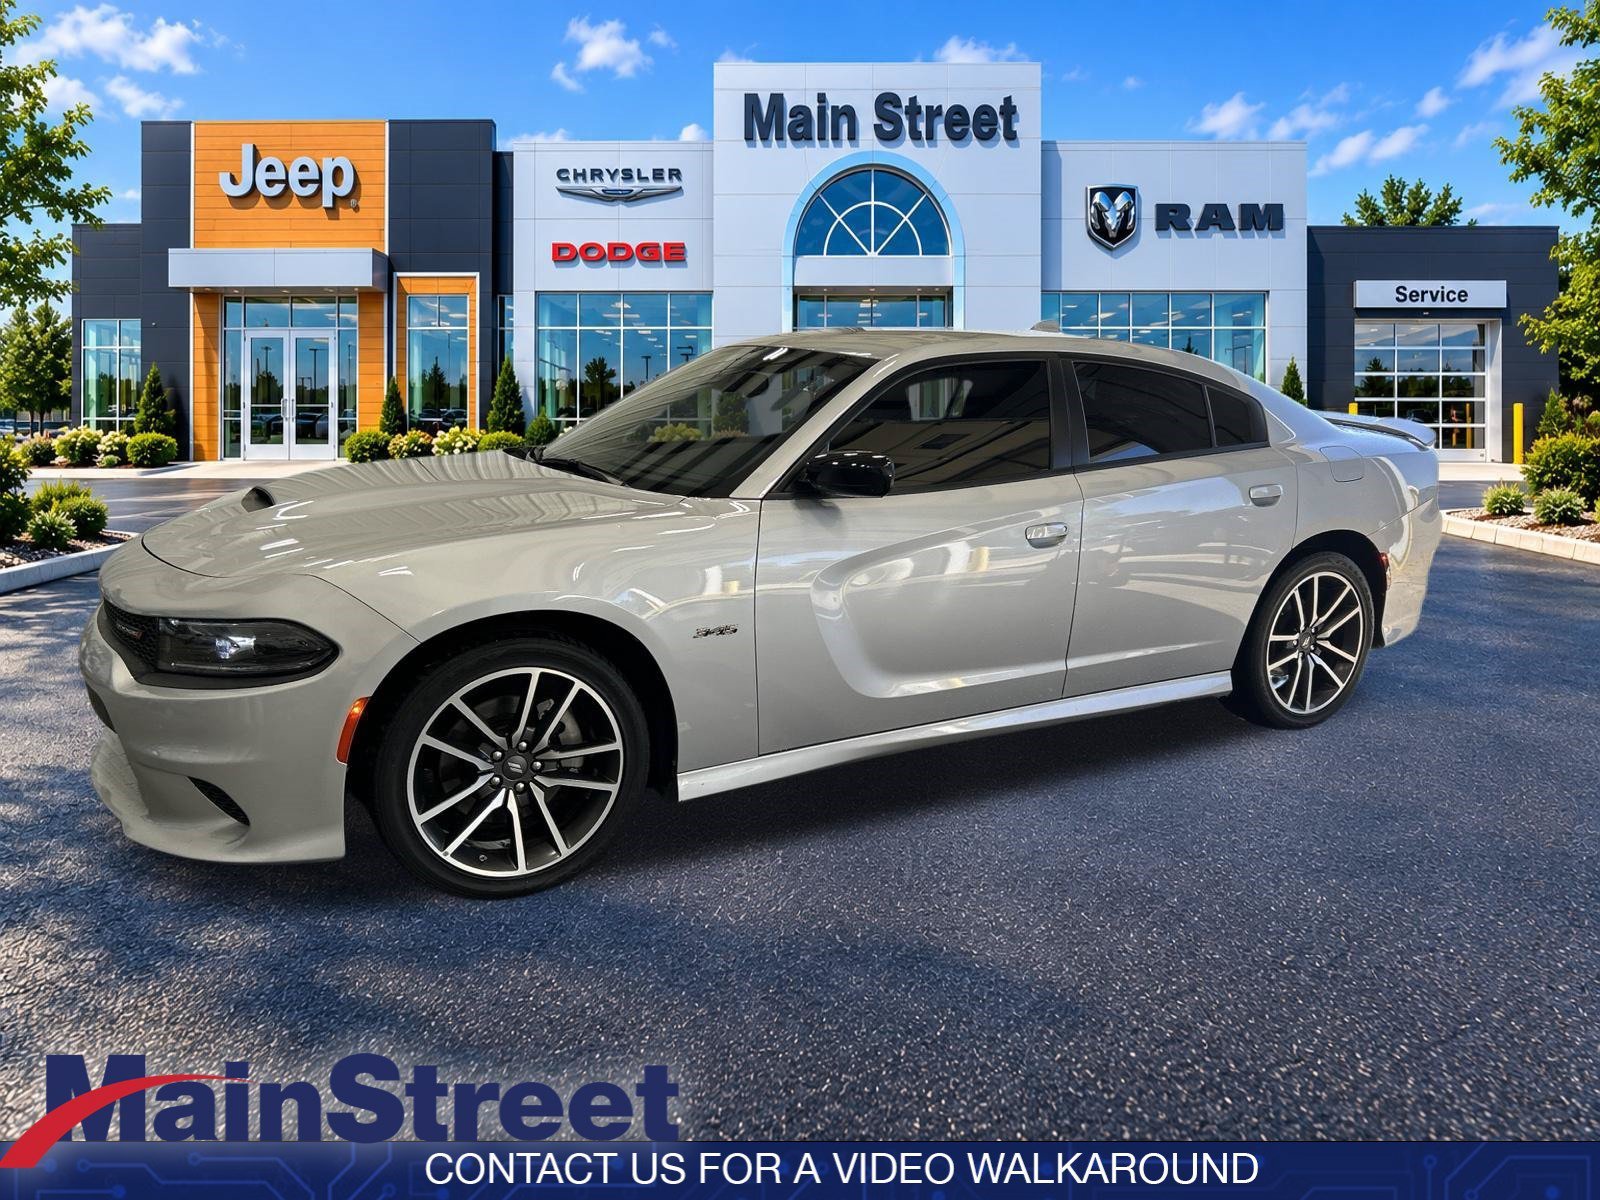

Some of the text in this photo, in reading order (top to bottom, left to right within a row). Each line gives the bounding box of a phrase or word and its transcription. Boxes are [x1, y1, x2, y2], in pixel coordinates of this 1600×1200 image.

[744, 93, 1018, 142] Main Street
[219, 144, 355, 209] Jeep
[556, 167, 682, 183] CHRYSLER
[1155, 203, 1284, 232] RAM
[551, 242, 686, 263] DODGE
[1395, 285, 1469, 303] Service
